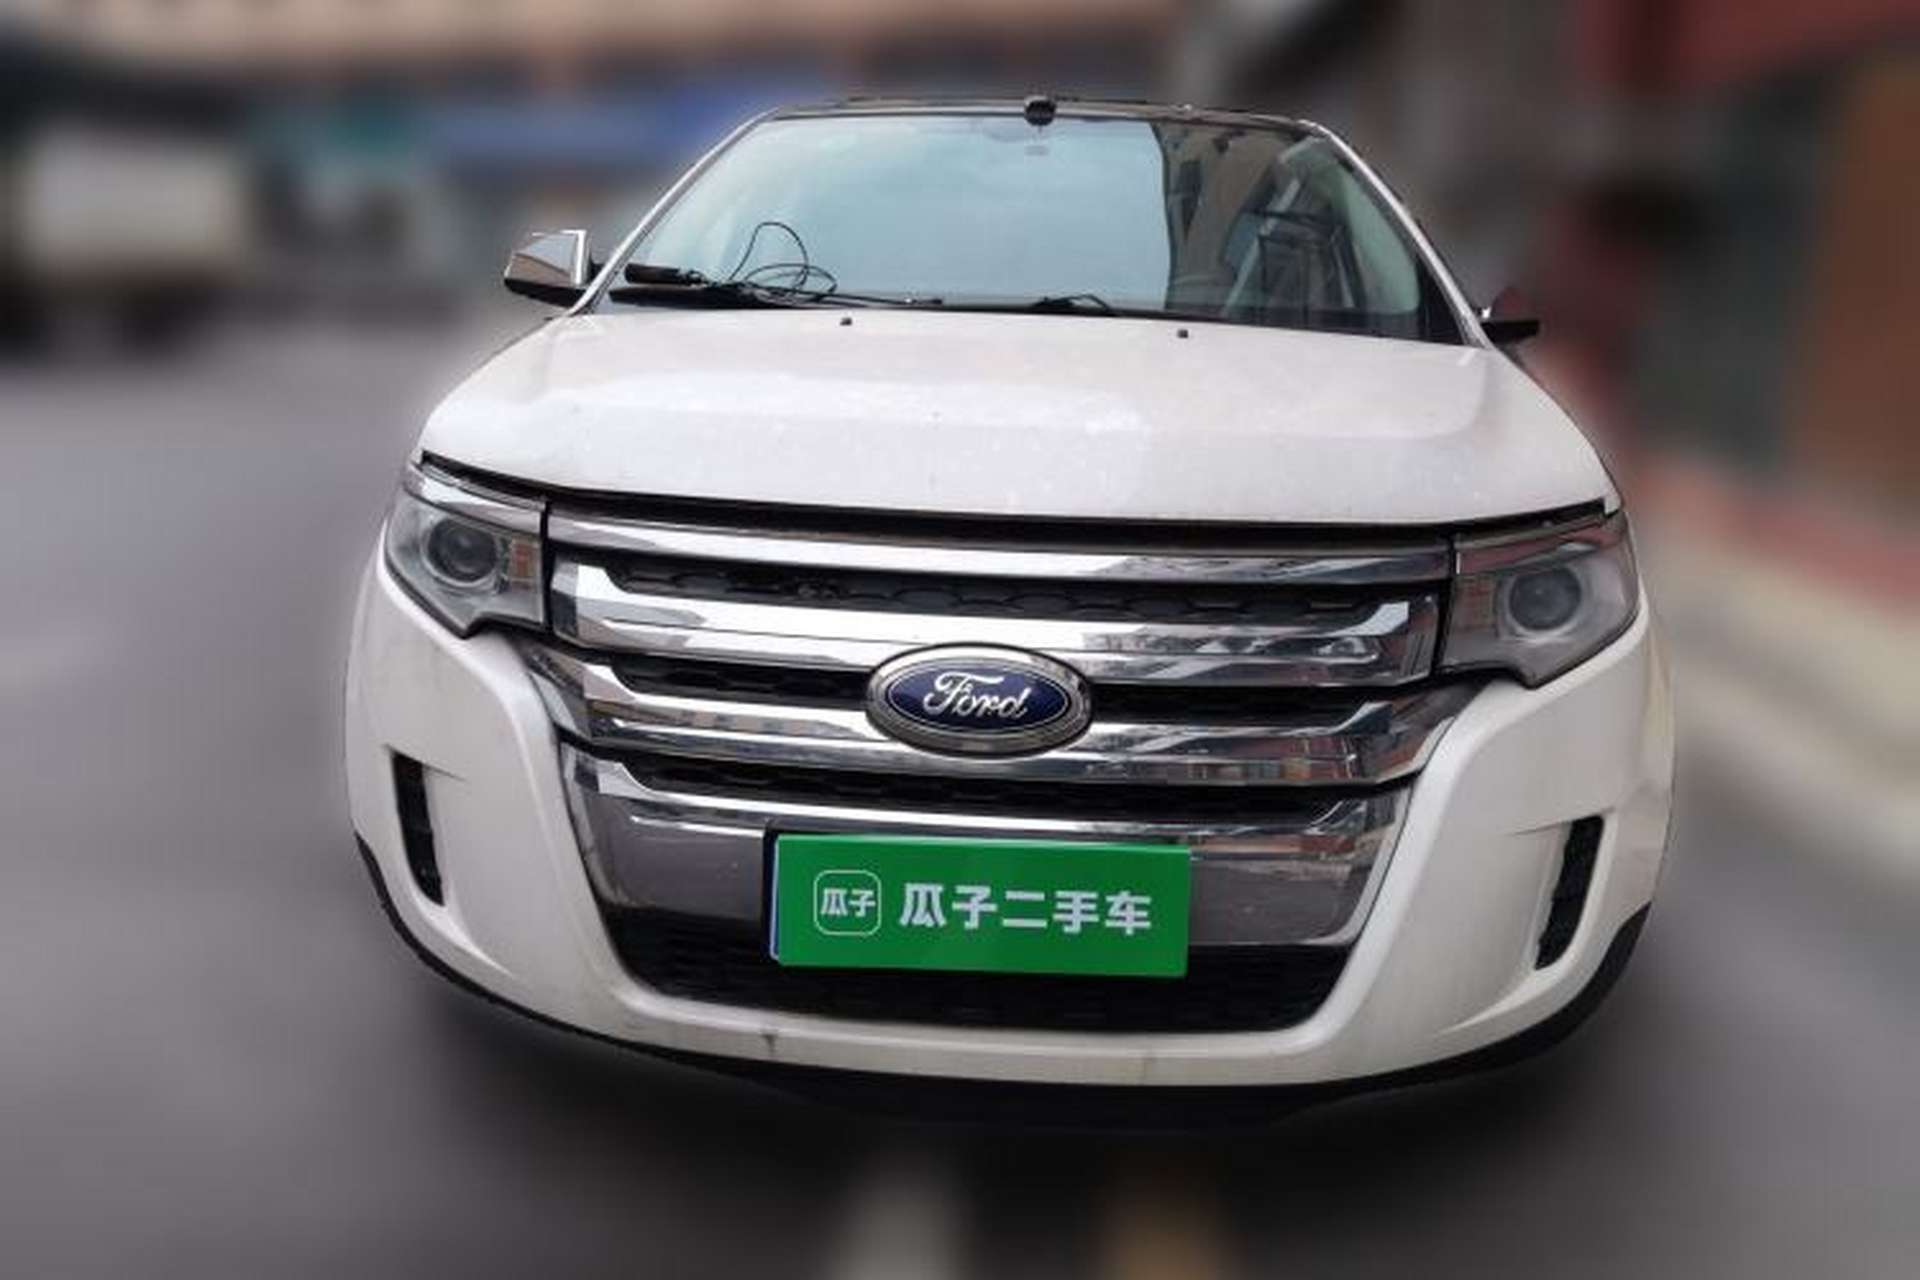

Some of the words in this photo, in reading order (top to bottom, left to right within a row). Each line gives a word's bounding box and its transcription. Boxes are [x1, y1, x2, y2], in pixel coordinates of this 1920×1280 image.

[922, 671, 1032, 718] Ford
[819, 887, 876, 917] 瓜子
[899, 882, 1153, 935] 瓜子二手车
